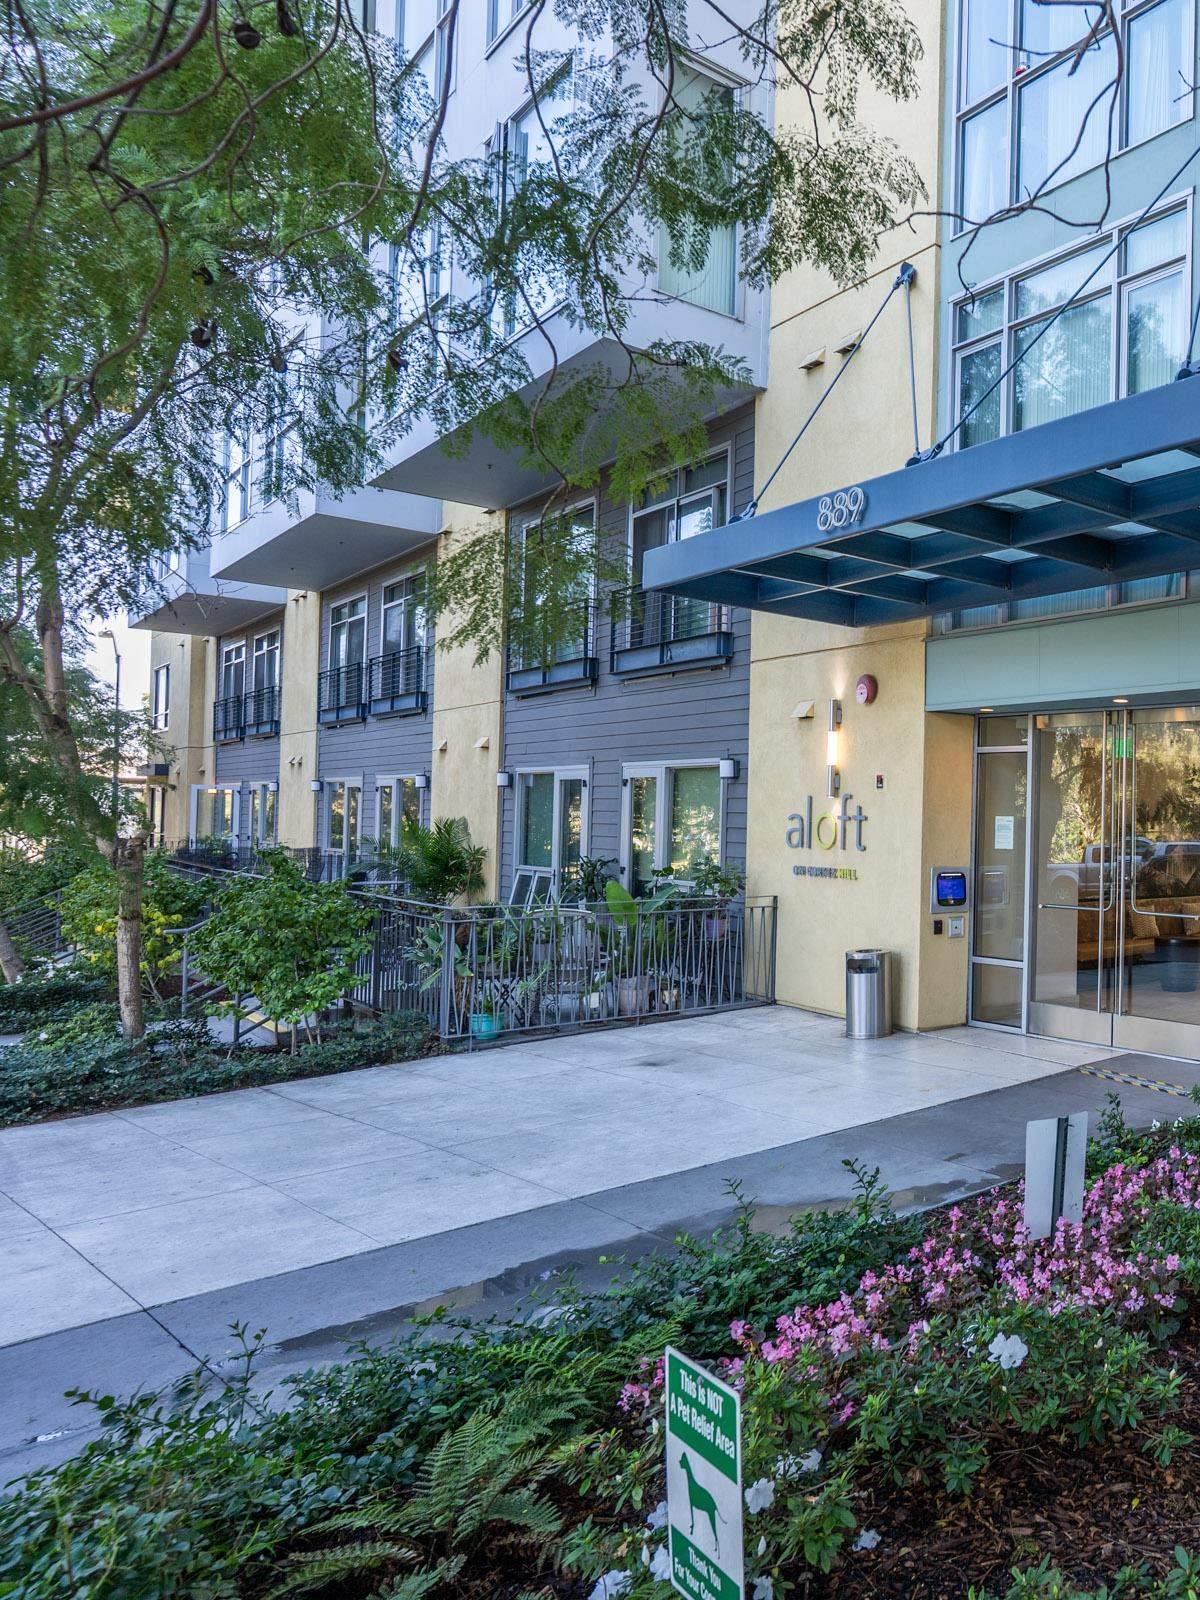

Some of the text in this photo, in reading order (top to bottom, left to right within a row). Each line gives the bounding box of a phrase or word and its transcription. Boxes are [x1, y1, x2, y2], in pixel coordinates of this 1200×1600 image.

[817, 487, 864, 531] 889
[785, 793, 868, 851] aloft
[680, 1369, 697, 1399] This
[707, 1388, 724, 1418] NOT
[670, 1392, 735, 1460] A Pet Relief Area
[674, 1556, 684, 1580] For
[685, 1567, 699, 1594] Your
[688, 1546, 721, 1591] Thank You
